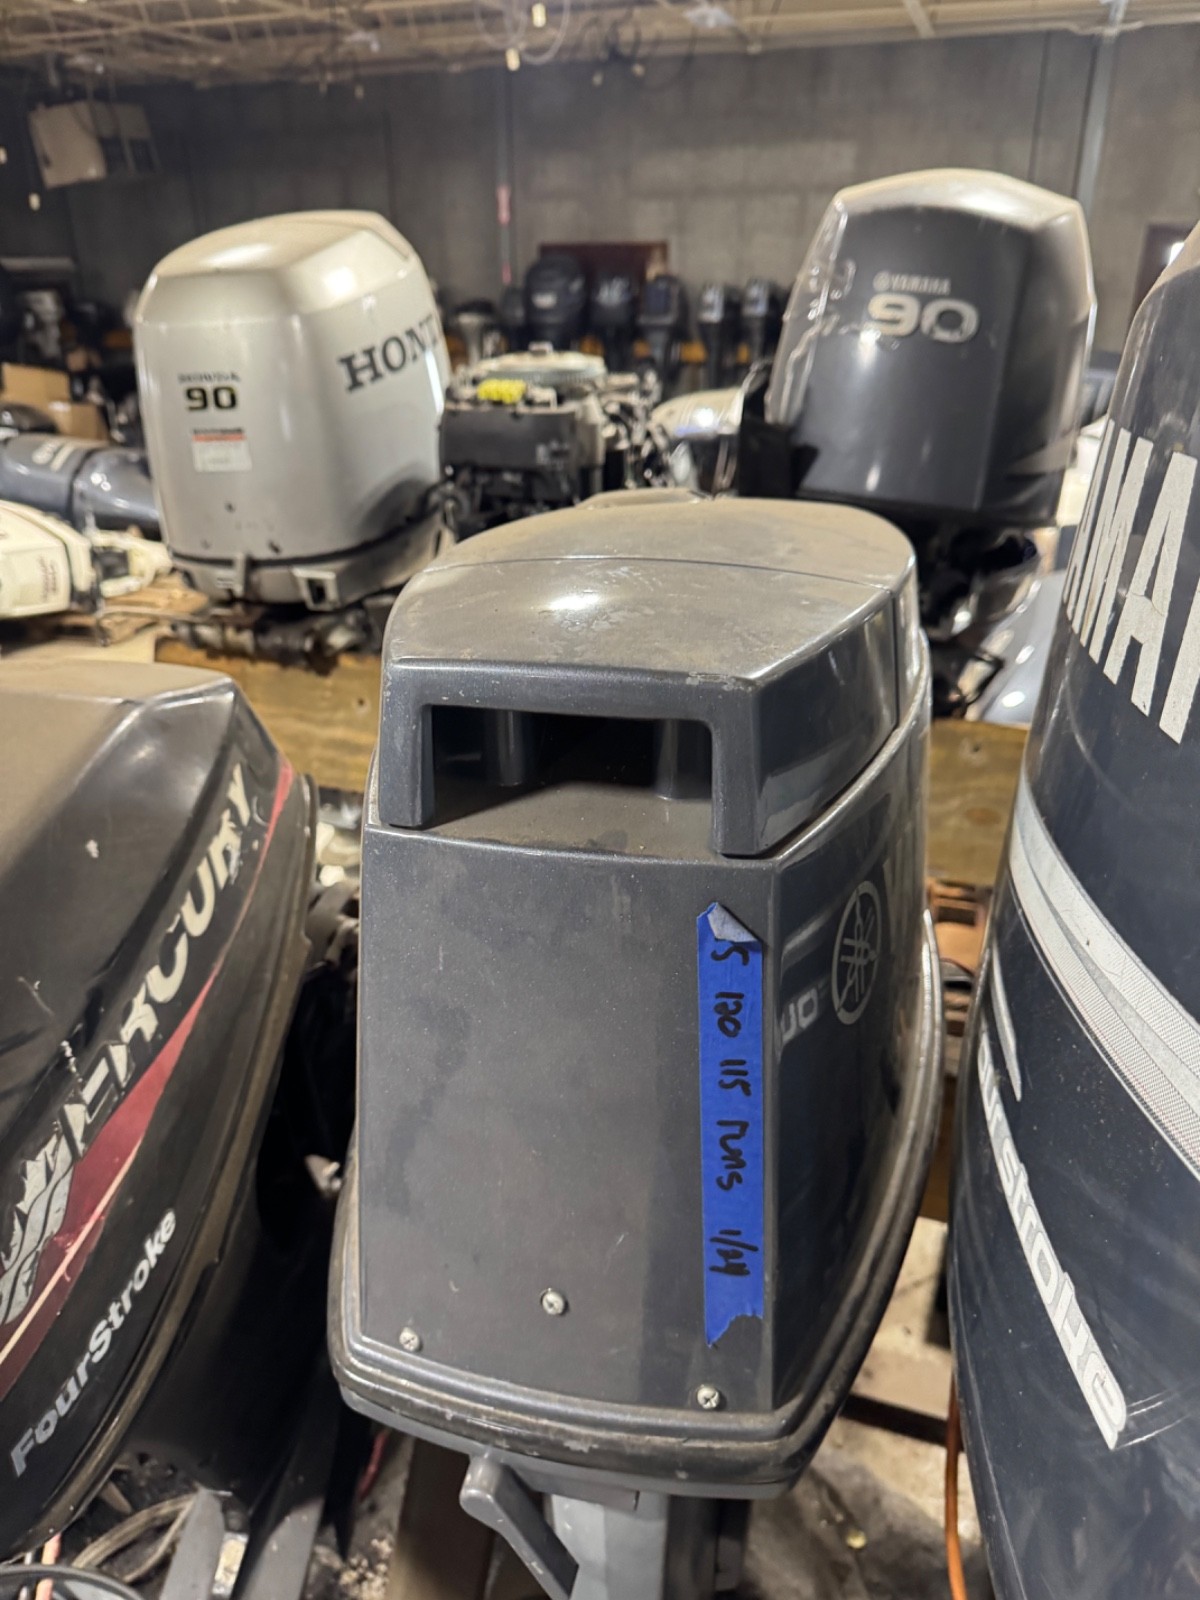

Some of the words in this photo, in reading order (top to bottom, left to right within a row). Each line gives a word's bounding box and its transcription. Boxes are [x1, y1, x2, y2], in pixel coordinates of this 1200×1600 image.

[864, 293, 979, 343] 90
[184, 385, 238, 412] 90
[718, 1058, 752, 1097] 115
[10, 1208, 177, 1478] FourStroke
